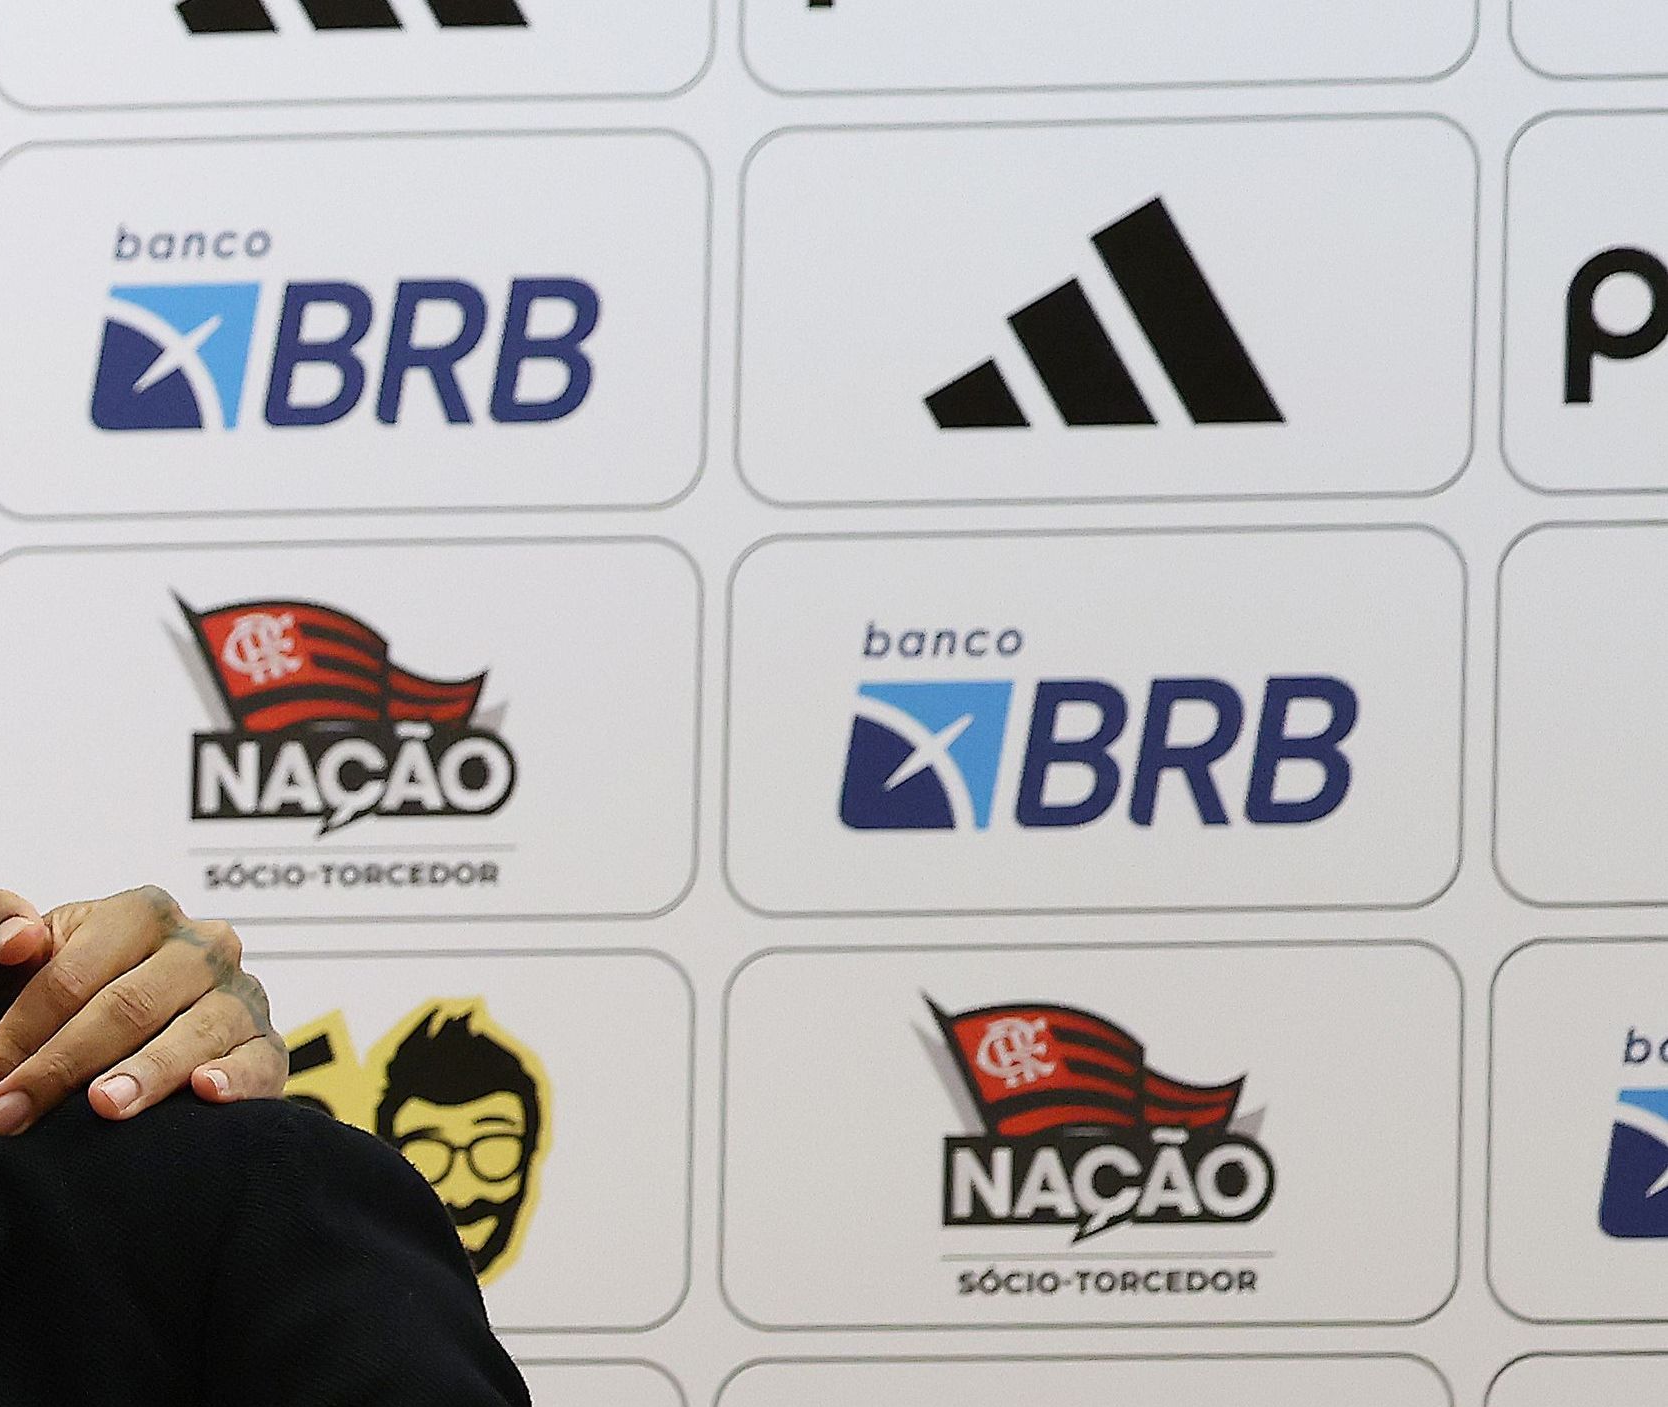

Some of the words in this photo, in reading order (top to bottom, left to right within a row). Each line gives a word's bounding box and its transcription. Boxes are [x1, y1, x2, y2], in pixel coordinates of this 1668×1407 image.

[114, 228, 271, 261] banco
[263, 277, 600, 428] BRB
[863, 624, 1022, 658] banco
[195, 722, 513, 825] NAÇÃO
[1014, 676, 1358, 828] BRB
[950, 1133, 1277, 1238] NAÇÃO
